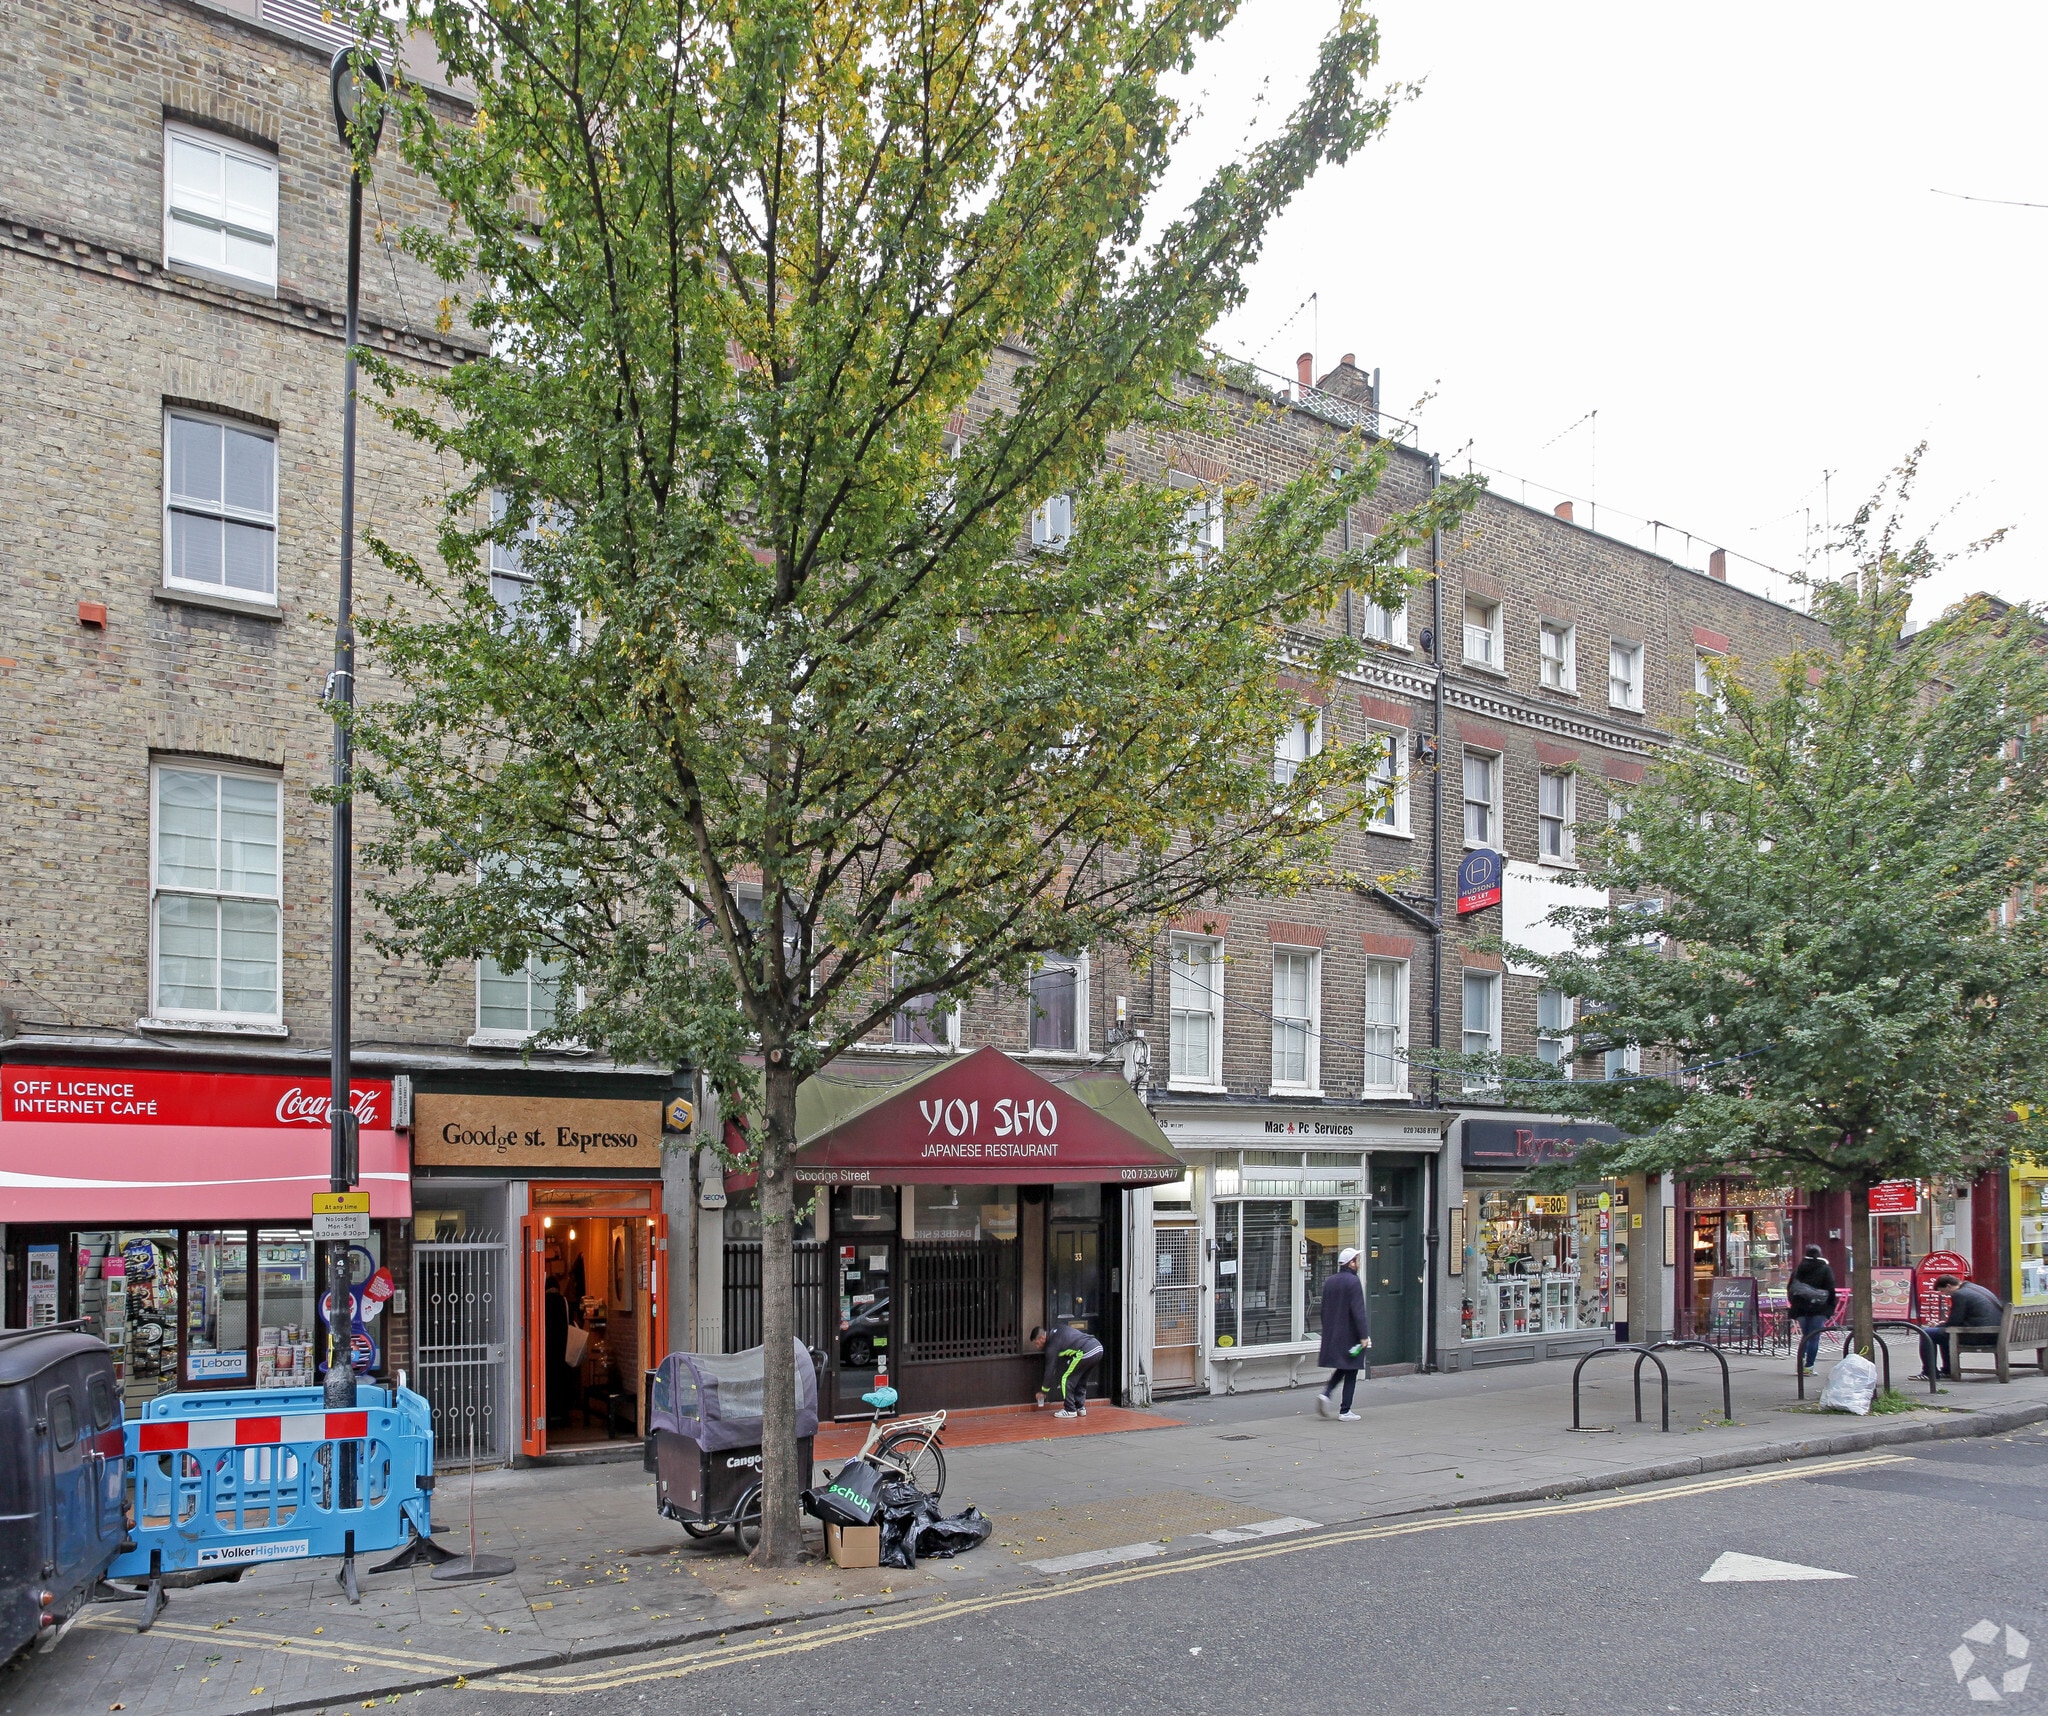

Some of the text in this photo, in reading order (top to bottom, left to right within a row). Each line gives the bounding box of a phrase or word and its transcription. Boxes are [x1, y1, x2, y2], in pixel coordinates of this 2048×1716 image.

[1462, 882, 1496, 896] HUDSONS
[1478, 891, 1489, 899] LET
[13, 1080, 134, 1097] OFF LICENCE
[14, 1099, 158, 1115] INTERNET CAFÉ
[673, 1107, 688, 1122] ADT
[919, 1098, 1059, 1137] YOI SHO
[1159, 1119, 1168, 1128] 35
[1265, 1121, 1284, 1133] Mac
[1298, 1122, 1310, 1134] Pc
[1314, 1122, 1353, 1135] Services
[442, 1123, 638, 1154] Goodge st. Espresso
[921, 1143, 1059, 1158] JAPANESE RESTAURANT
[795, 1170, 871, 1183] Goodge Street
[1121, 1168, 1178, 1179] 020 7323 0477
[133, 1254, 148, 1262] KP
[1074, 1252, 1083, 1261] 33
[259, 1348, 276, 1356] Sun
[202, 1359, 242, 1369] Lebara
[726, 1454, 763, 1468] Cango
[829, 1484, 871, 1514] schuh
[221, 1543, 306, 1560] VolkerHighways
